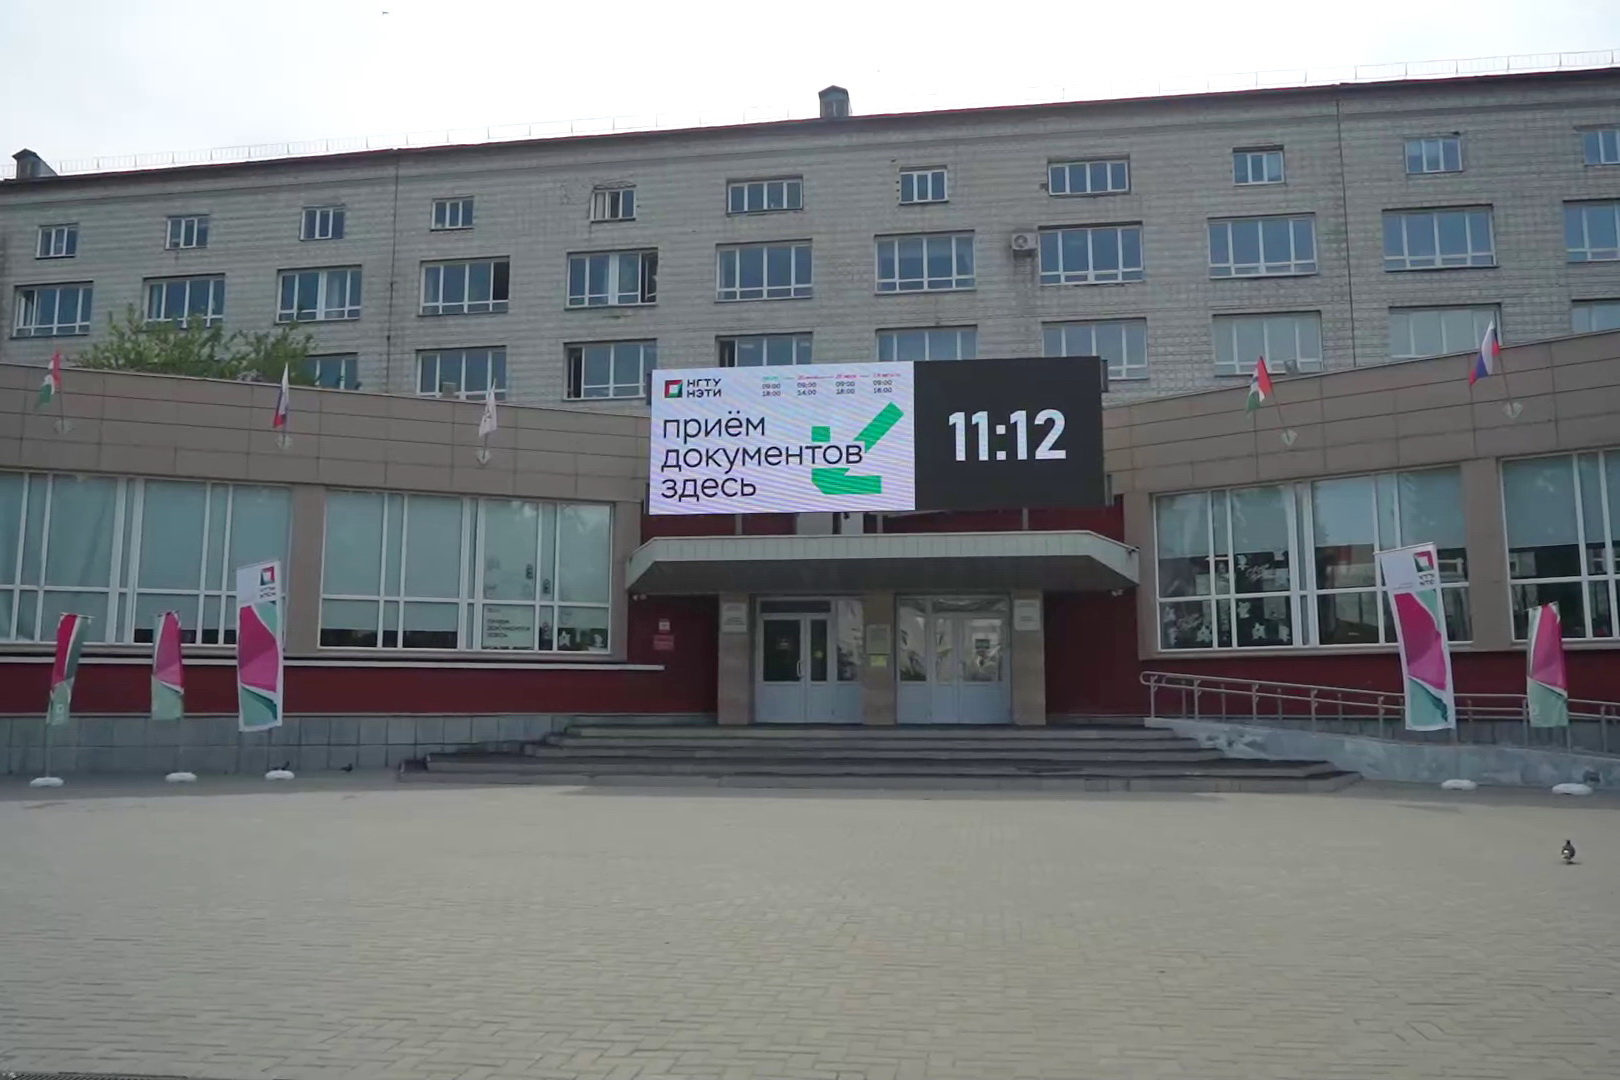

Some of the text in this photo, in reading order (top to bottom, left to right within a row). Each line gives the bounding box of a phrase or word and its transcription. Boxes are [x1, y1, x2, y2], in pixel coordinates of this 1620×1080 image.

[686, 378, 722, 388] НГТУ
[686, 388, 722, 398] НЭТИ
[663, 410, 766, 445] приём
[948, 408, 1067, 461] 11:12
[661, 444, 863, 475] документов
[661, 477, 757, 502] здесь
